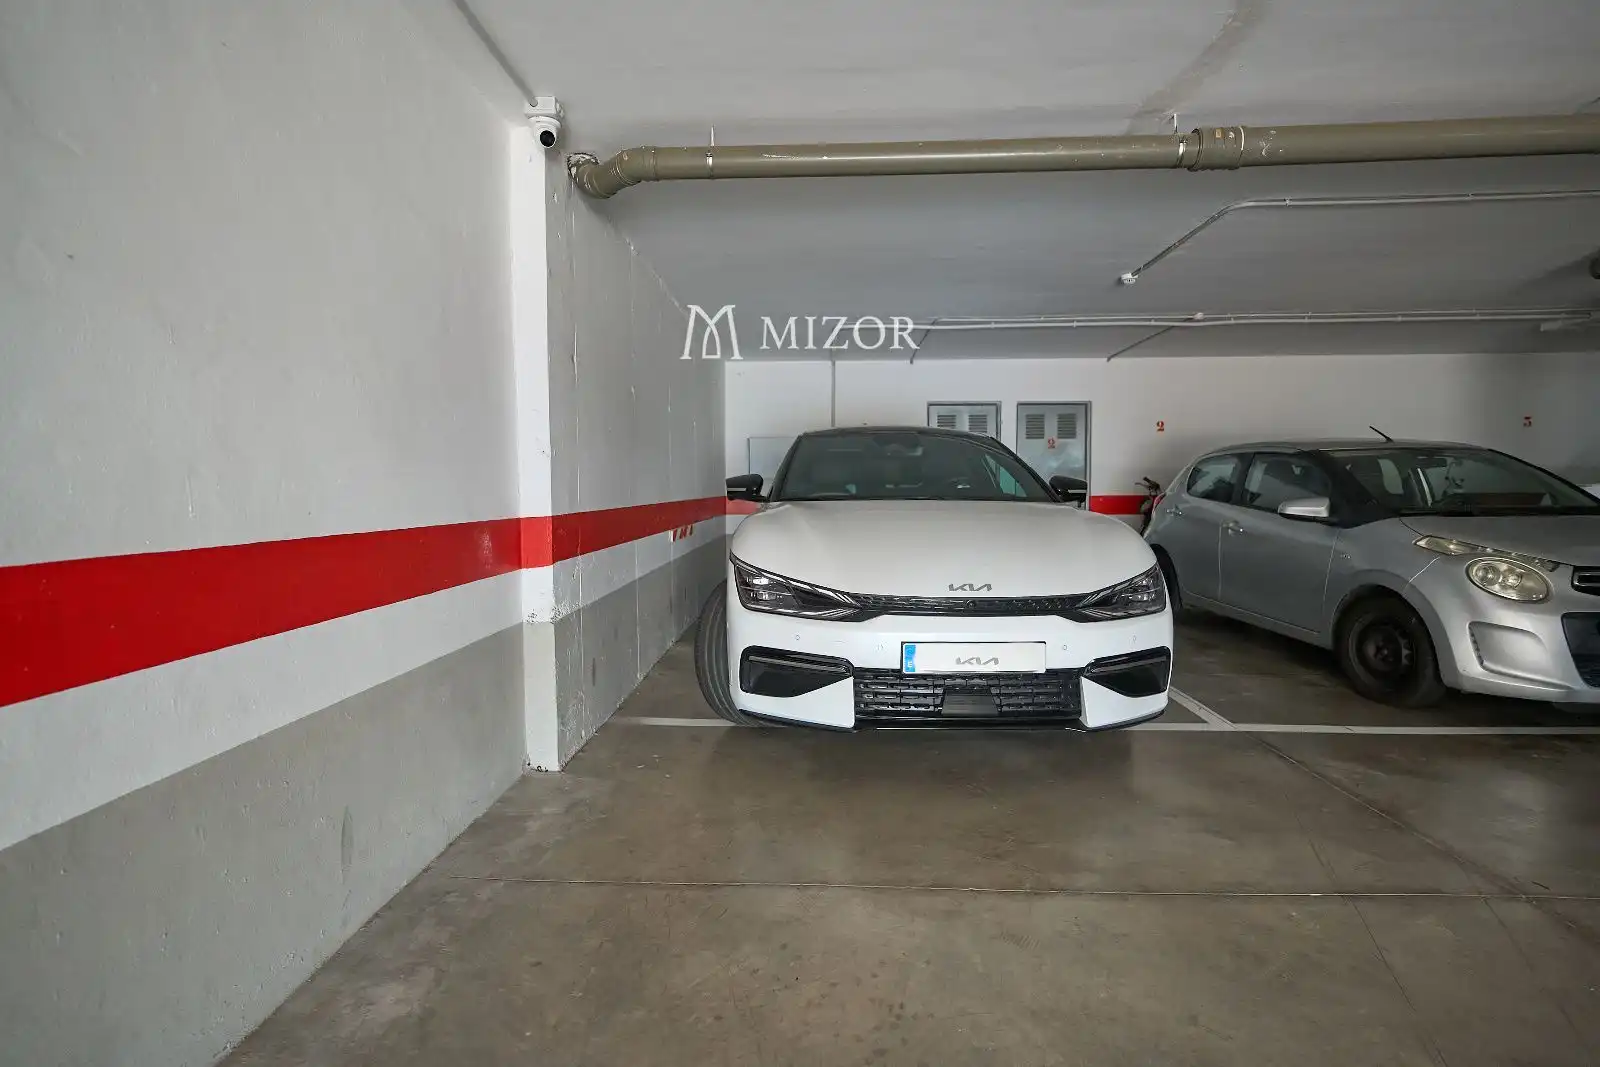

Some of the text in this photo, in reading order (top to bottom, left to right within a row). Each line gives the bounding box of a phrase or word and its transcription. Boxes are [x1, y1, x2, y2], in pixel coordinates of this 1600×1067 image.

[1155, 420, 1165, 432] 2
[1047, 437, 1056, 449] 2
[948, 583, 993, 592] KIA
[955, 656, 1000, 666] KIA
